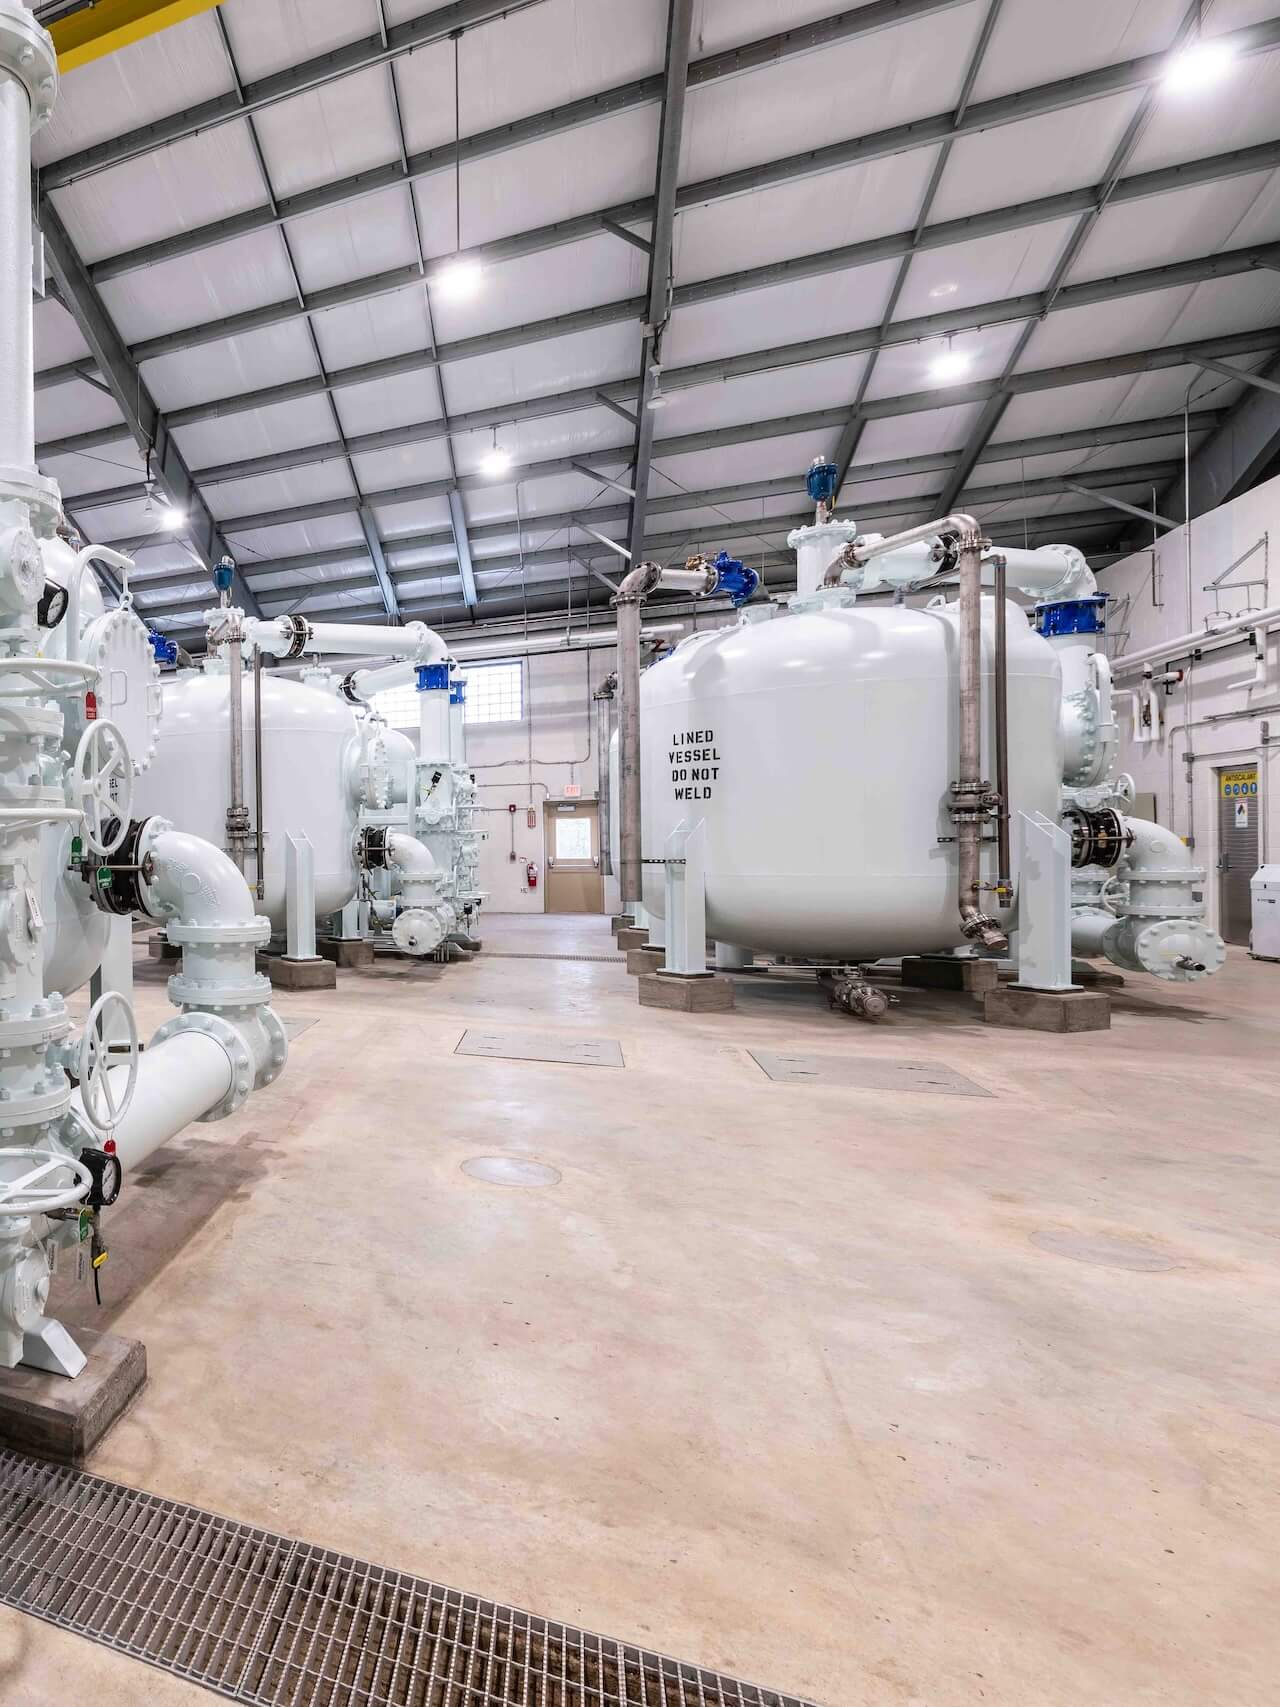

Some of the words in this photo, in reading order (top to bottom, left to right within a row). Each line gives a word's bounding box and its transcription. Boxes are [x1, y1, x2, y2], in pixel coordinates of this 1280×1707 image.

[673, 730, 714, 746] LINED
[668, 748, 720, 764] VESSEL
[672, 769, 687, 782] DO
[691, 767, 719, 781] NOT
[1225, 773, 1257, 782] ANTISCALANT
[674, 786, 712, 800] WELD
